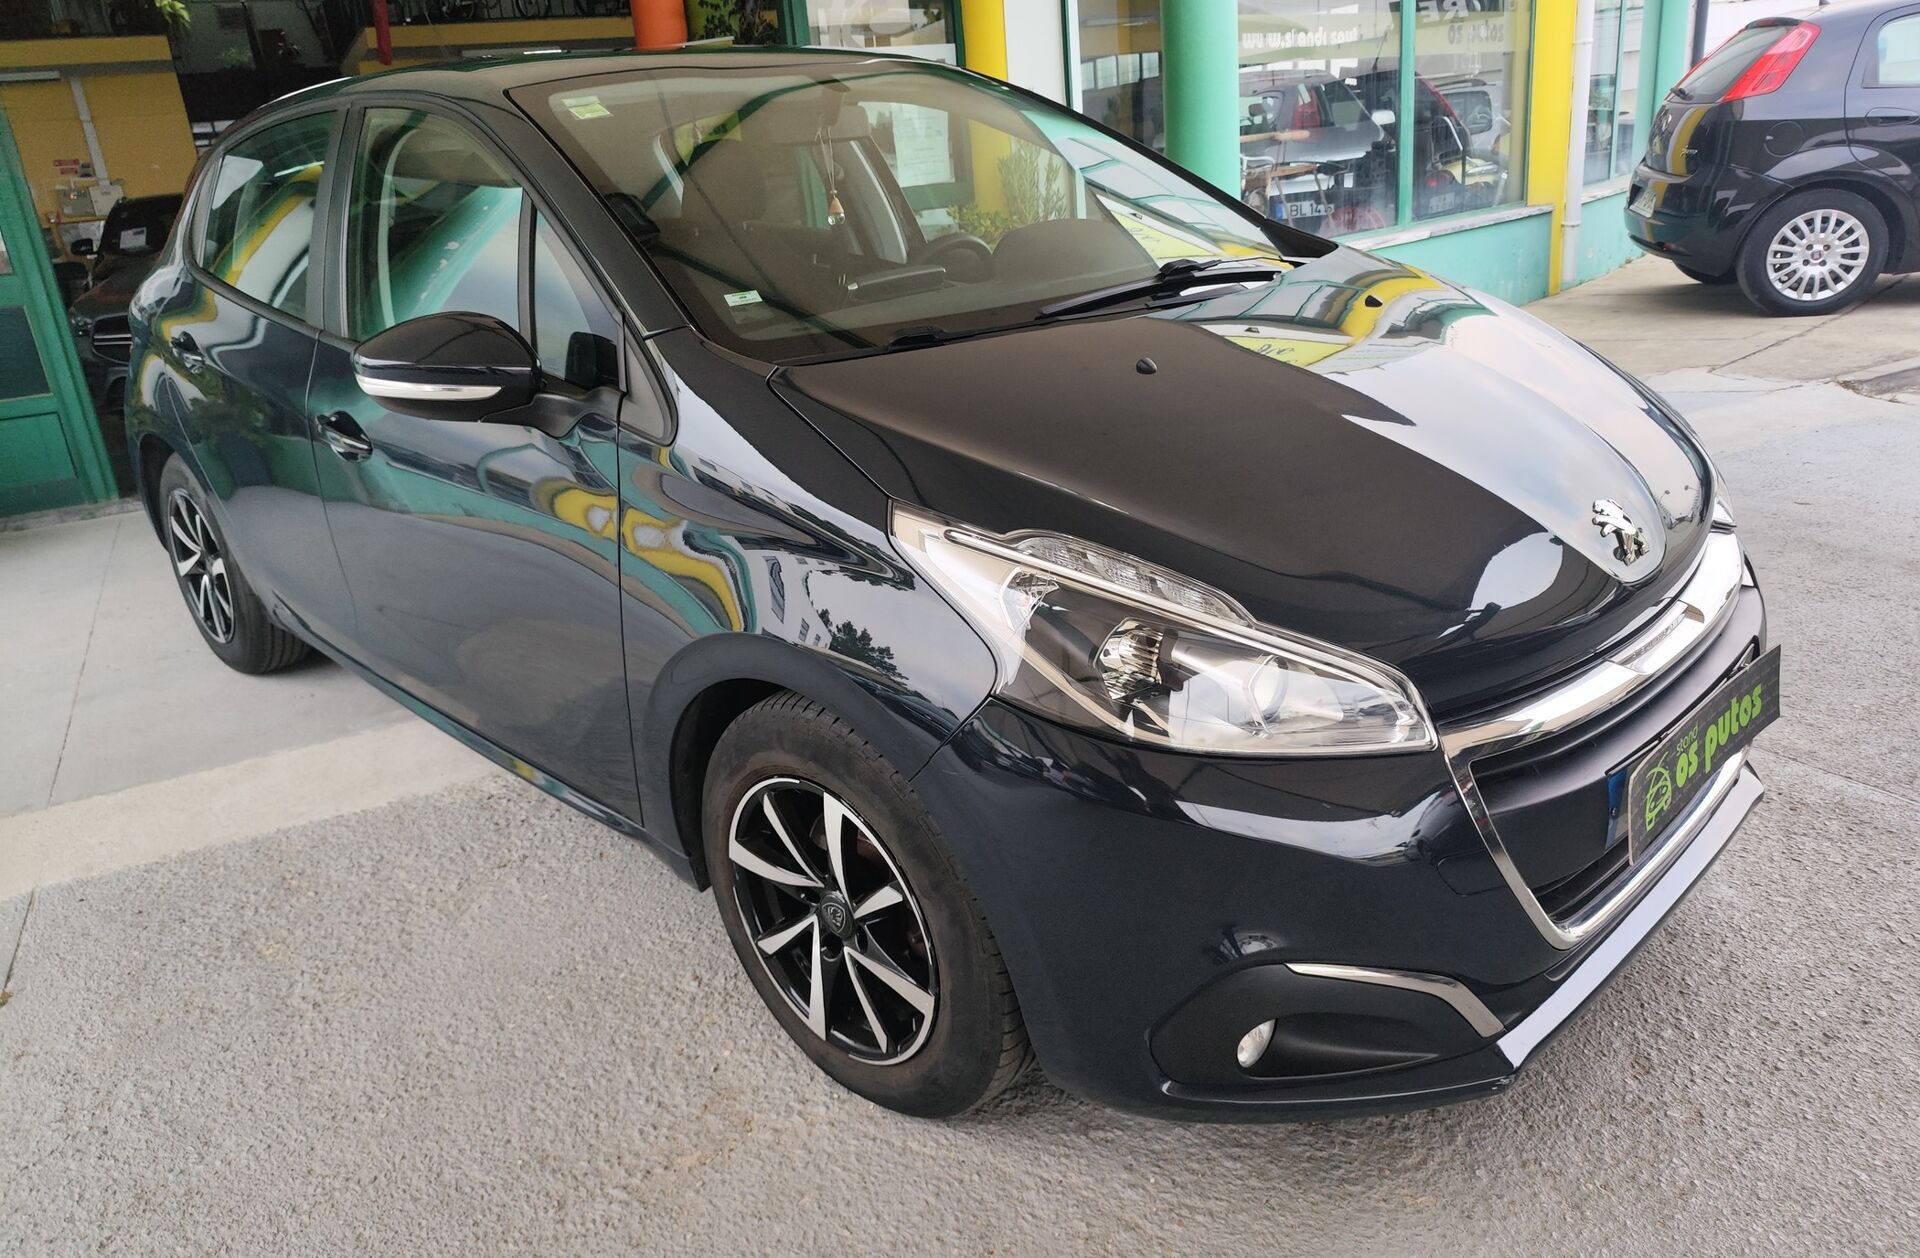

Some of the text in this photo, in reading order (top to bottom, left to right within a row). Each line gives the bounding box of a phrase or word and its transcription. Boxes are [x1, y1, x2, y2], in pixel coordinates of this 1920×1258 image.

[1676, 684, 1762, 788] os putos
[1676, 725, 1698, 756] stand
